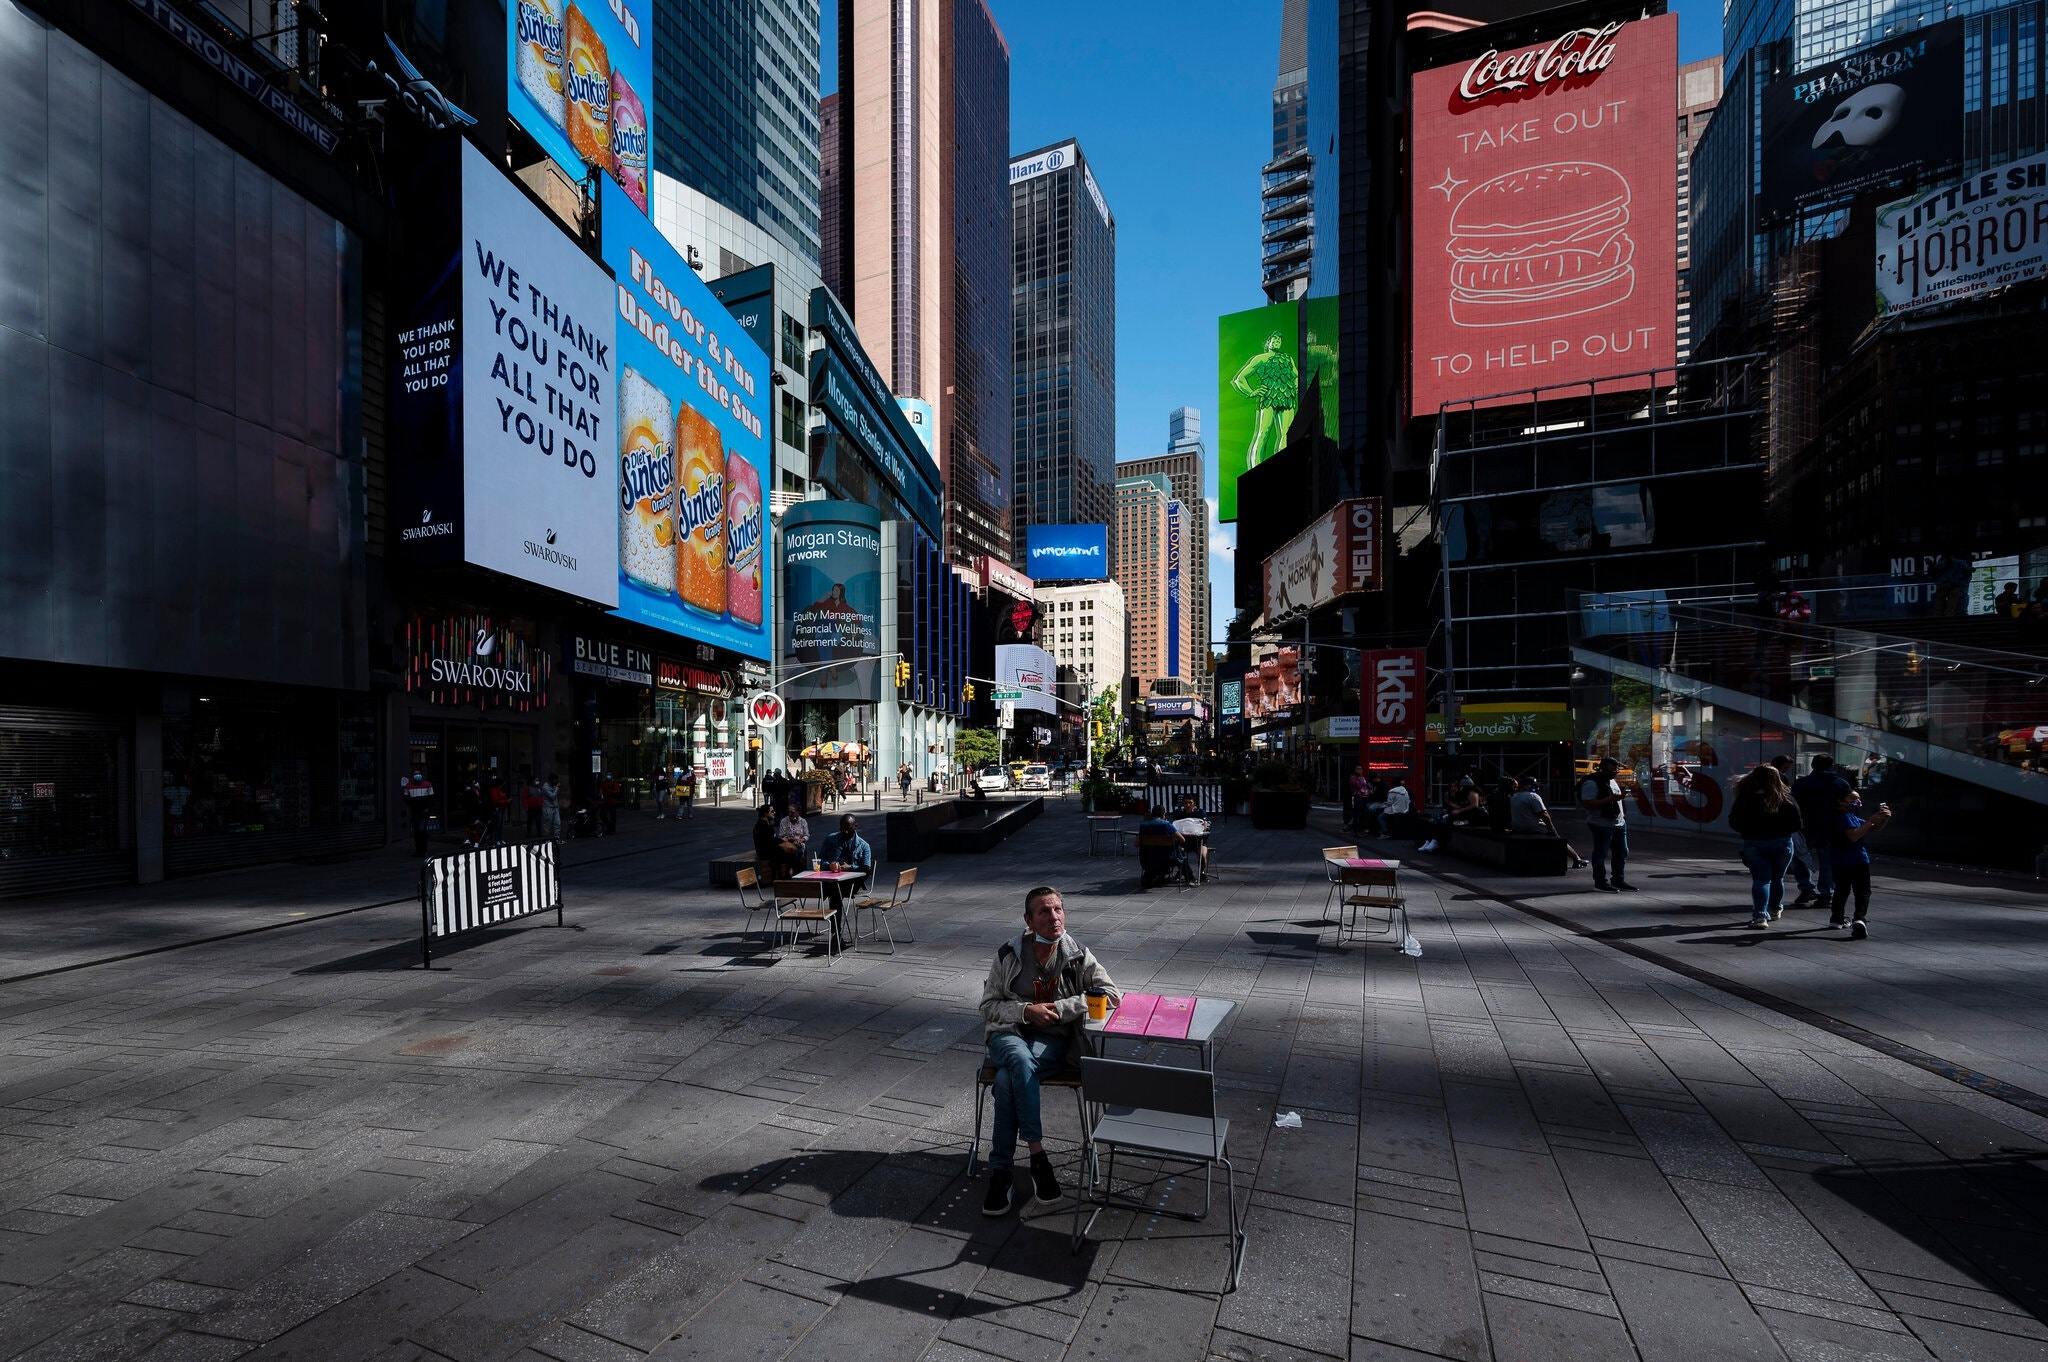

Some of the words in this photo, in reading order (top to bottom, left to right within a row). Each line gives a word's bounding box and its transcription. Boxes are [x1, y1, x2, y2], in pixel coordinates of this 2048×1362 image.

[518, 1, 563, 52] Sunkist
[1460, 20, 1627, 99] Coca-Cola
[1793, 40, 1927, 100] PHANTOM
[1840, 52, 1875, 69] THE
[568, 60, 610, 109] Sunkist
[1804, 91, 1825, 104] OF
[1829, 79, 1860, 95] THE
[1861, 60, 1914, 85] OPERA
[271, 92, 332, 146] PRIME
[612, 117, 646, 157] Sunkist
[1457, 118, 1540, 154] TAKE
[1553, 100, 1627, 134] OUT
[1898, 173, 1998, 240] LITTLE
[1972, 202, 1993, 215] OF
[1888, 294, 1940, 313] Westside
[1943, 281, 1988, 298] Theatre
[1996, 271, 2018, 284] 407
[2023, 266, 2035, 277] W
[1926, 255, 2042, 292] LittleShopNYC.com
[475, 239, 519, 303] WE
[528, 283, 610, 373] THANK
[630, 247, 705, 346] Flavor
[708, 331, 722, 365] &
[724, 346, 755, 398] Fun
[398, 325, 415, 345] WE
[417, 318, 456, 338] THANK
[403, 340, 427, 360] YOU
[429, 338, 451, 353] FOR
[826, 304, 841, 334] Your
[841, 328, 865, 373] Company
[403, 359, 422, 378] ALL
[424, 355, 451, 373] THAT
[489, 297, 548, 366] YOU
[558, 349, 601, 405] FOR
[618, 284, 693, 376] Under
[696, 356, 729, 409] the
[732, 392, 762, 440] Sun
[1431, 352, 1472, 377] TO
[1486, 340, 1570, 369] HELP
[1582, 327, 1656, 356] OUT
[405, 376, 429, 394] YOU
[431, 373, 449, 388] DO
[490, 352, 537, 405] ALL
[545, 383, 600, 442] THAT
[496, 397, 554, 456] YOU
[564, 437, 597, 479] DO
[828, 371, 858, 429] Morgan
[859, 412, 884, 463] Stanley
[885, 451, 891, 469] at
[892, 455, 906, 488] Work
[631, 452, 646, 468] Diet
[622, 447, 673, 513] Sunkist
[652, 493, 673, 514] Orange
[679, 475, 724, 541] Sunkist
[403, 522, 454, 541] SWAROVSKI
[705, 520, 722, 541] Orange
[727, 507, 761, 566] Sunkist
[787, 532, 834, 550] Morgan
[838, 530, 880, 555] Stanley
[1169, 508, 1179, 570] NOVOTEL
[1353, 503, 1373, 588] HELLO!
[524, 540, 577, 571] SWAROVSKI
[787, 554, 796, 563] AT
[797, 550, 827, 560] WORK
[1032, 546, 1100, 558] INNOVATIVE
[1288, 551, 1324, 589] MORMON
[1890, 557, 1916, 576] NO
[793, 611, 818, 623] Equity
[820, 610, 874, 623] Management
[796, 623, 832, 634] Financial
[835, 623, 872, 636] Wellness
[576, 637, 619, 666] BLUE
[627, 649, 650, 671] FIN
[792, 637, 837, 648] Retirement
[841, 637, 876, 650] Solutions
[431, 658, 532, 694] SWAROVSKI
[576, 664, 617, 677] SEAFOOD
[660, 662, 681, 685] DOS
[683, 667, 721, 693] CAMINOS
[1376, 656, 1416, 725] tkts
[754, 701, 779, 721] W
[1462, 722, 1516, 738] Garden
[712, 768, 726, 777] OPEN
